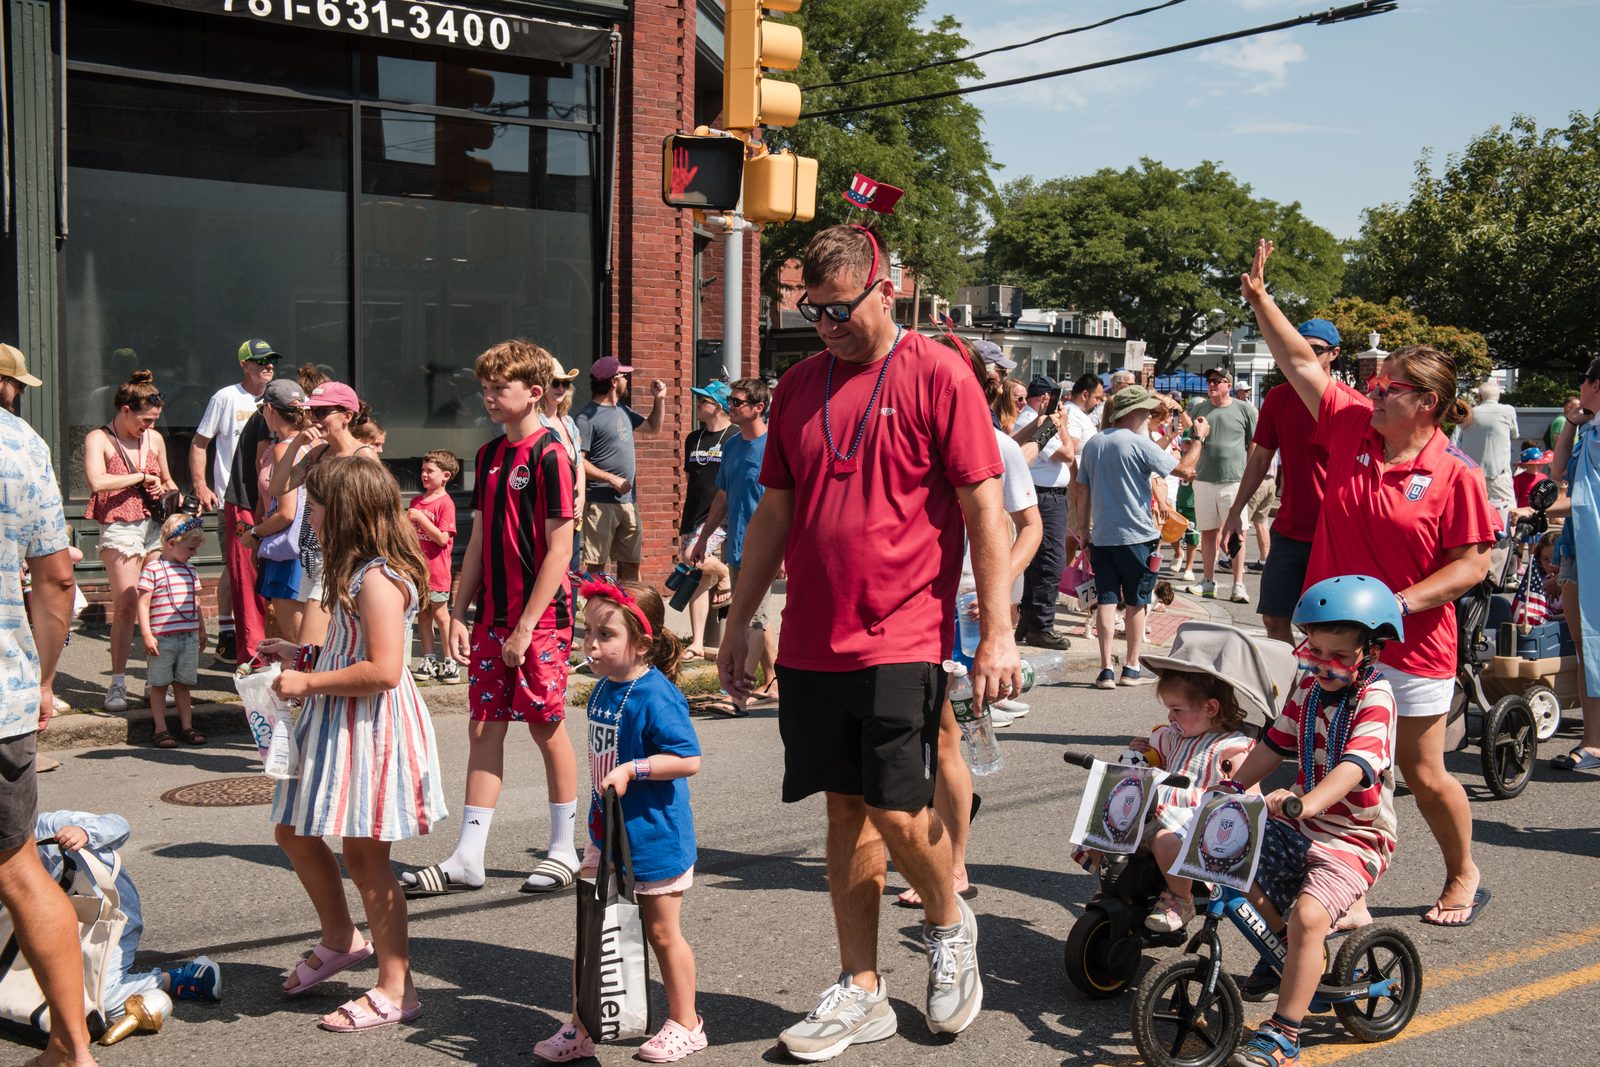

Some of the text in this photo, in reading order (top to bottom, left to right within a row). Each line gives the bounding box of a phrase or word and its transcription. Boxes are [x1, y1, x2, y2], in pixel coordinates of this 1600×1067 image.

[1082, 586, 1097, 603] 73
[589, 723, 615, 754] USA
[1235, 902, 1288, 964] STRIDE
